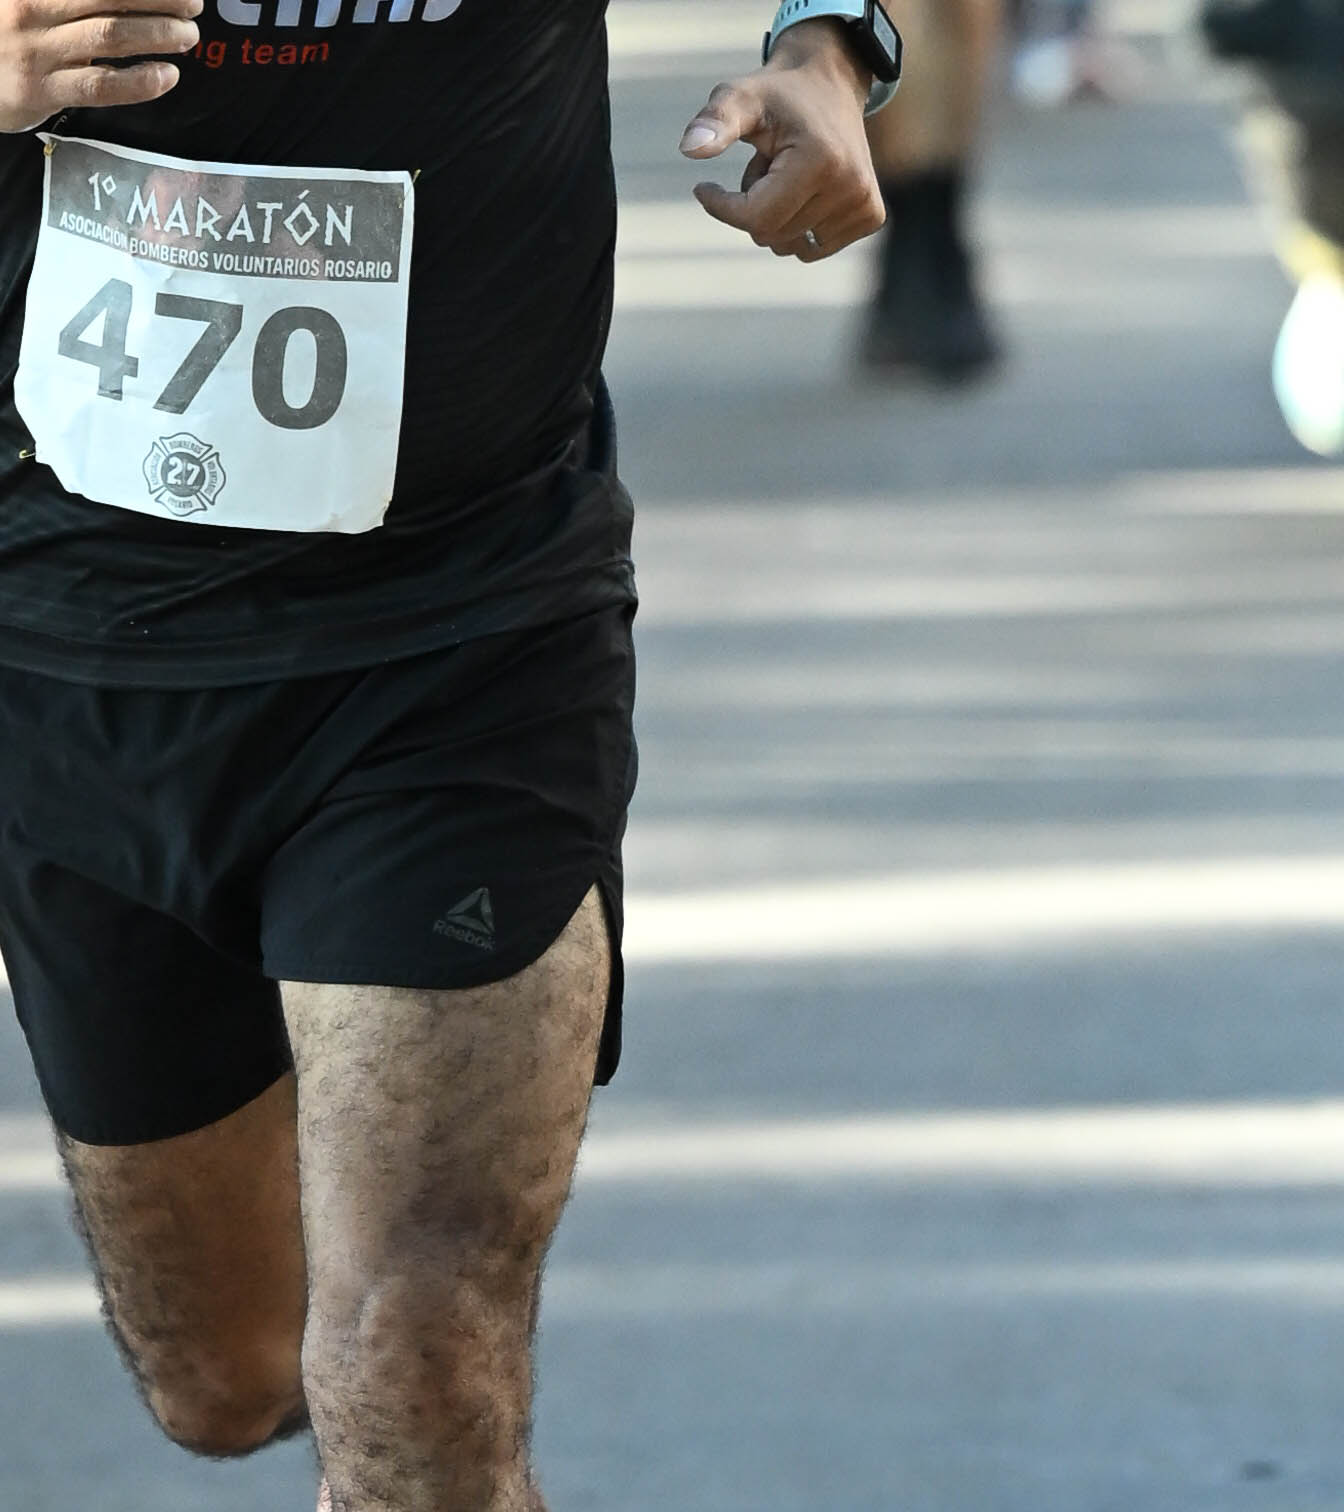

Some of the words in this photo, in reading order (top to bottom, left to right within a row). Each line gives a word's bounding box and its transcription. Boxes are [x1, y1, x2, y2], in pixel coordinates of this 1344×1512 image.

[241, 39, 330, 66] team
[126, 184, 354, 246] MARATÓN
[129, 236, 209, 269] BOMBEROS
[213, 251, 320, 277] VOLUNTARIOS
[324, 259, 393, 280] ROSARIO
[58, 277, 348, 431] 470
[166, 455, 201, 486] 27
[432, 919, 497, 953] Reebok
